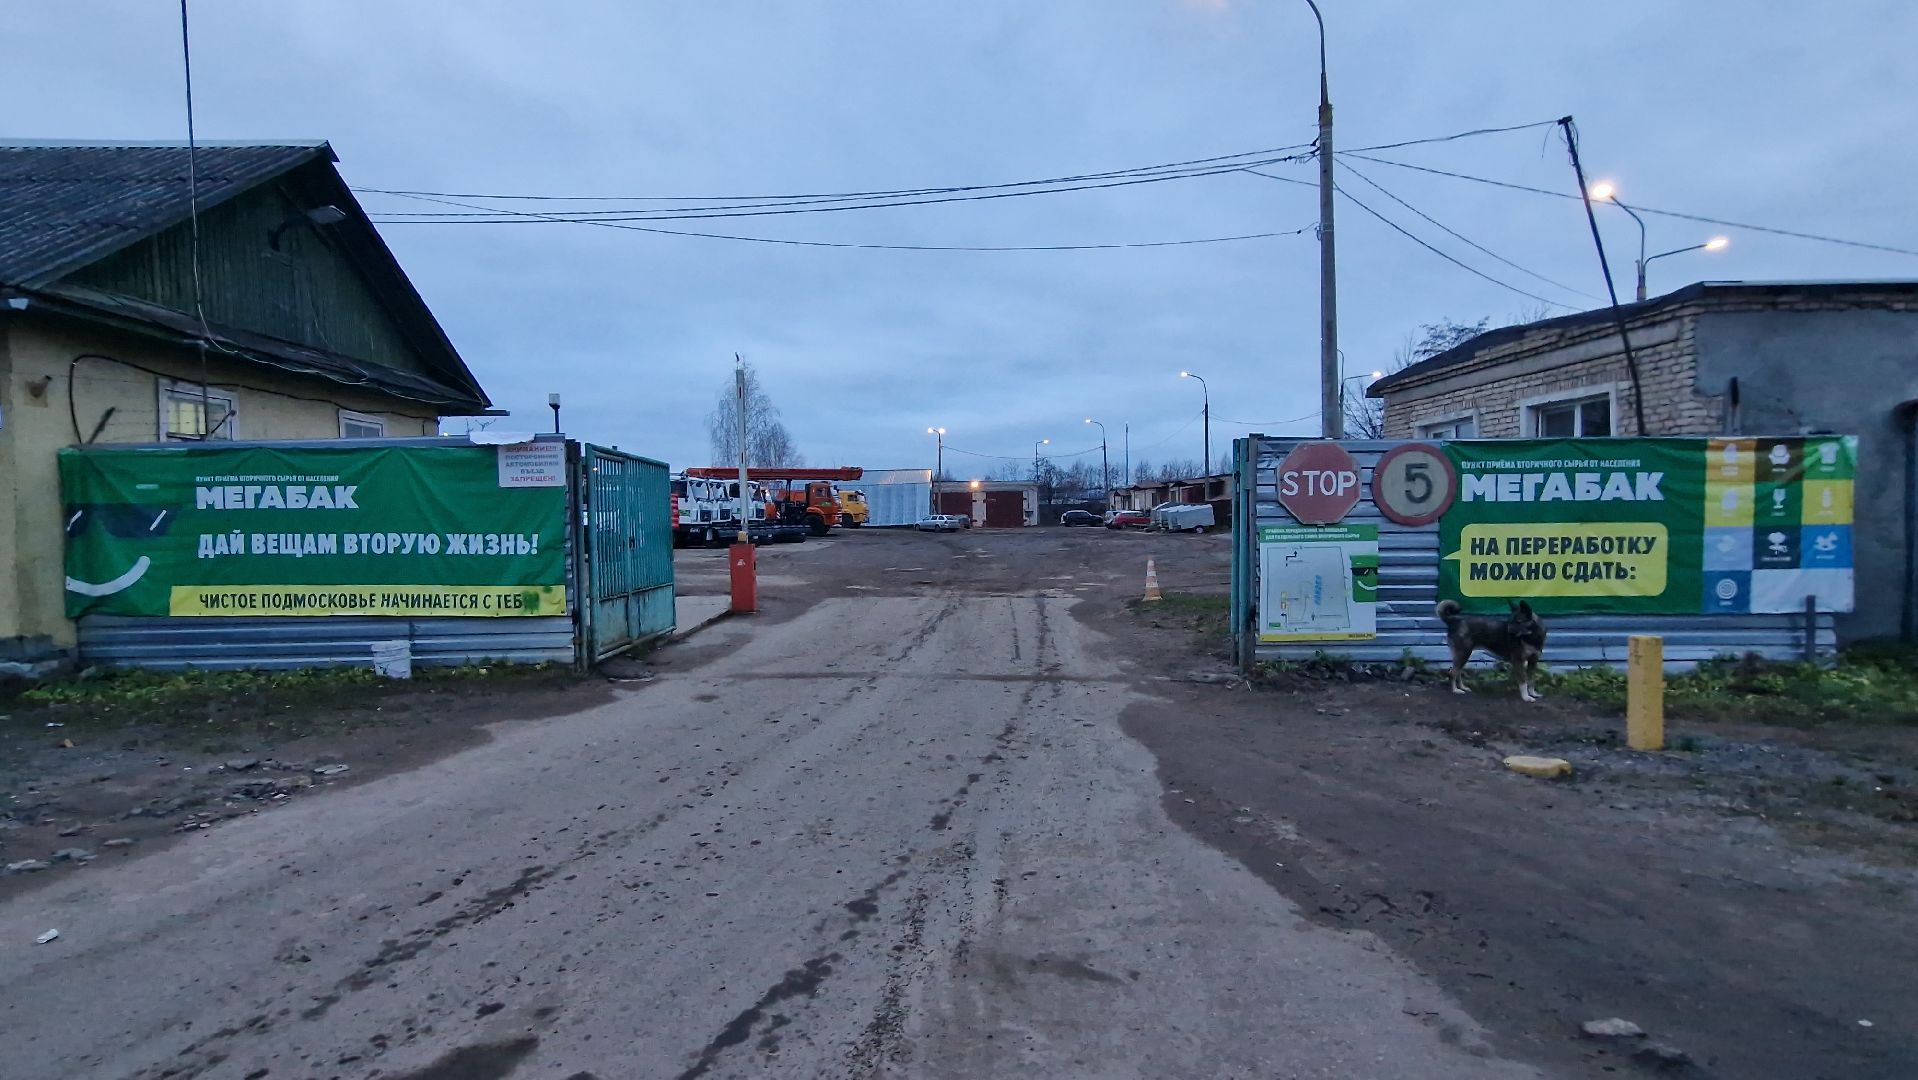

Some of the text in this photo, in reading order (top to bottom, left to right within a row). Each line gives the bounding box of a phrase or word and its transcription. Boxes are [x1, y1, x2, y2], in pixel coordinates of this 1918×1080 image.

[1461, 460, 1485, 470] ПУНКТ
[1517, 460, 1562, 469] ВТОРИЧНОГО
[1563, 459, 1588, 468] СЫРЬЯ
[1589, 459, 1599, 468] ОТ
[1600, 459, 1641, 467] НАСЕЛЕНИЯ
[1281, 470, 1356, 497] STOP
[1405, 462, 1433, 504] 5
[1462, 472, 1664, 502] МЕГАБАК
[196, 485, 359, 509] МЕГАБАК
[198, 529, 539, 559] ДАЙ ВЕЩАМ ВТОРУЮ ЖИЗНЬ!
[1470, 536, 1657, 556] НА ПЕРЕРАБОТКУ
[1470, 562, 1636, 583] МОЖНО СДАТЬ:
[199, 593, 533, 611] ЧИСТОЕ ПОДМОСКОВЬЕ НАЧИНАЕТСЯ С ТЕБ
